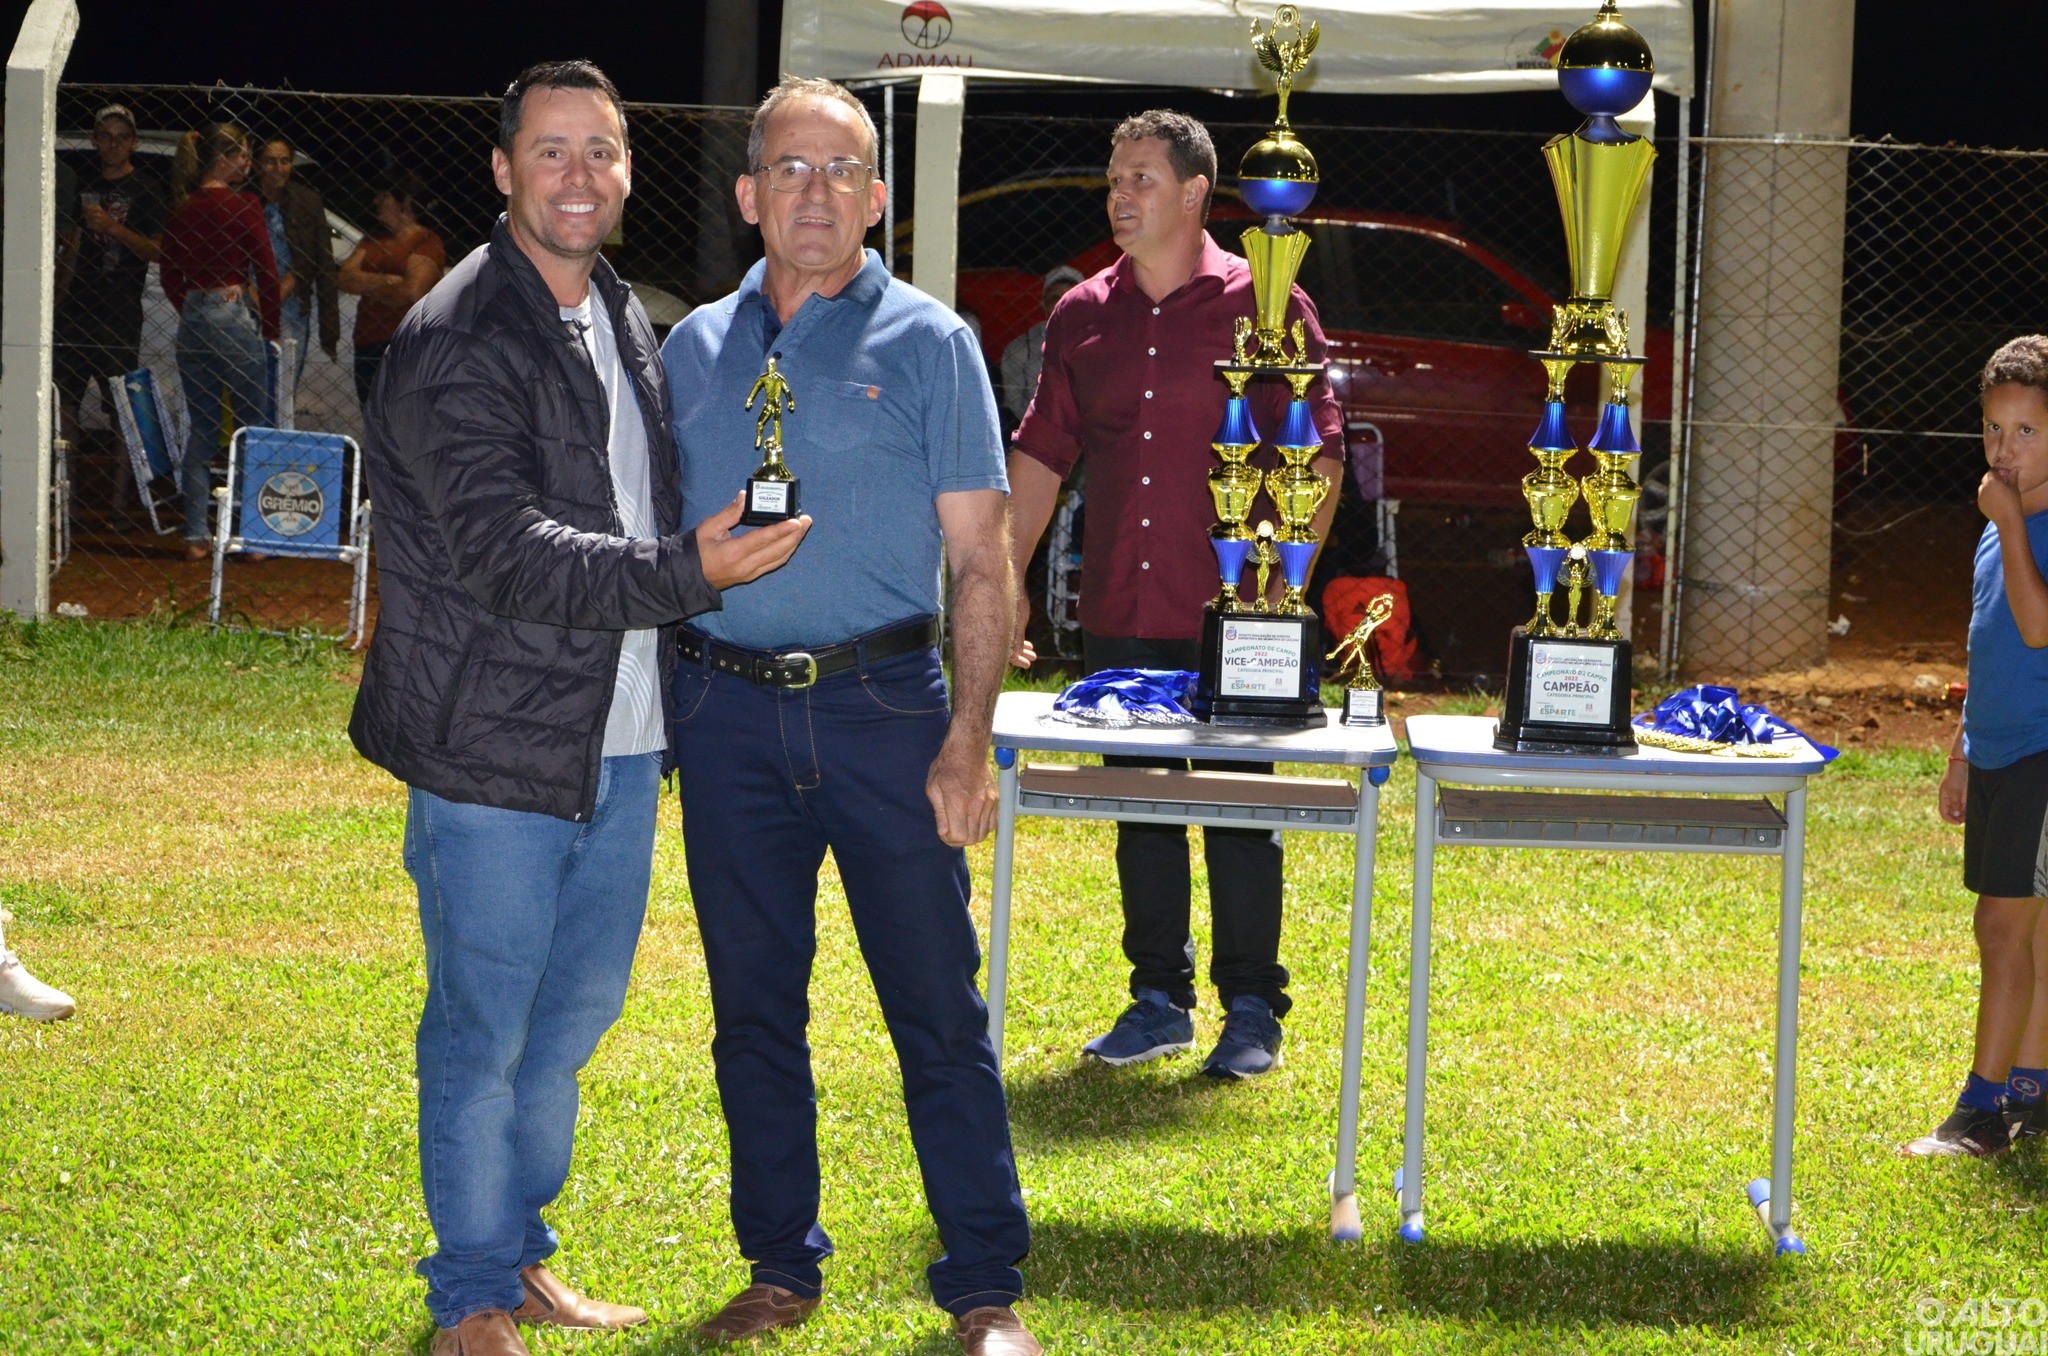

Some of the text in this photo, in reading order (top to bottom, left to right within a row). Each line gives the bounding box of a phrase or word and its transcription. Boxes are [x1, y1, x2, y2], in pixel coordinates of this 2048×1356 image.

[1227, 645, 1266, 655] CAMPEONATO
[1276, 647, 1296, 657] CAMPO
[1587, 671, 1608, 682] CAMPO
[1543, 680, 1600, 694] CAMPEÃO
